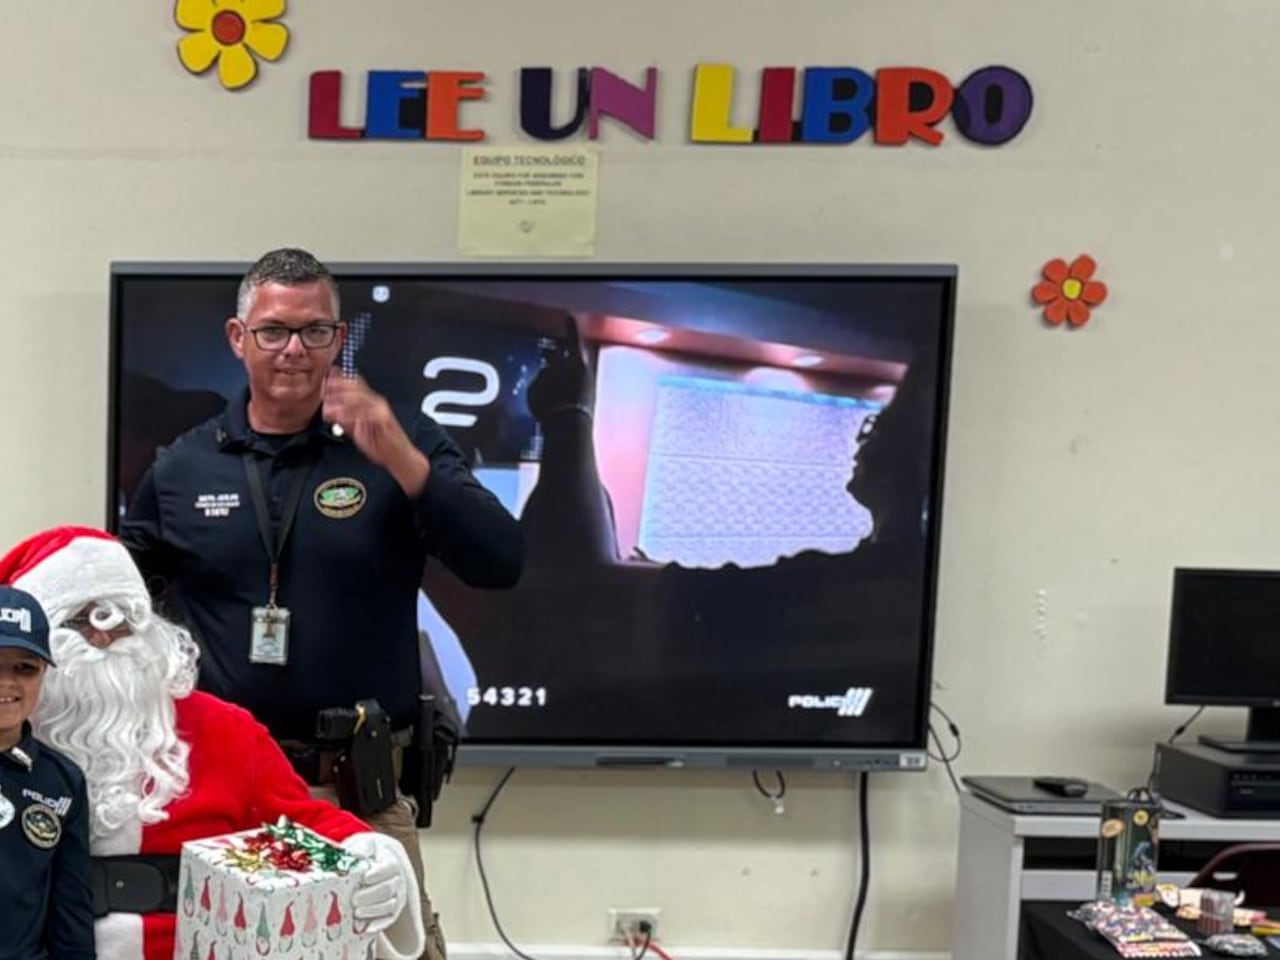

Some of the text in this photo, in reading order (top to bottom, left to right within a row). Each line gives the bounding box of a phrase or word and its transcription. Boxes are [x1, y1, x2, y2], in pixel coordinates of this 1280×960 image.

[307, 62, 1034, 146] LEE UN LIBRO
[421, 356, 500, 427] 2
